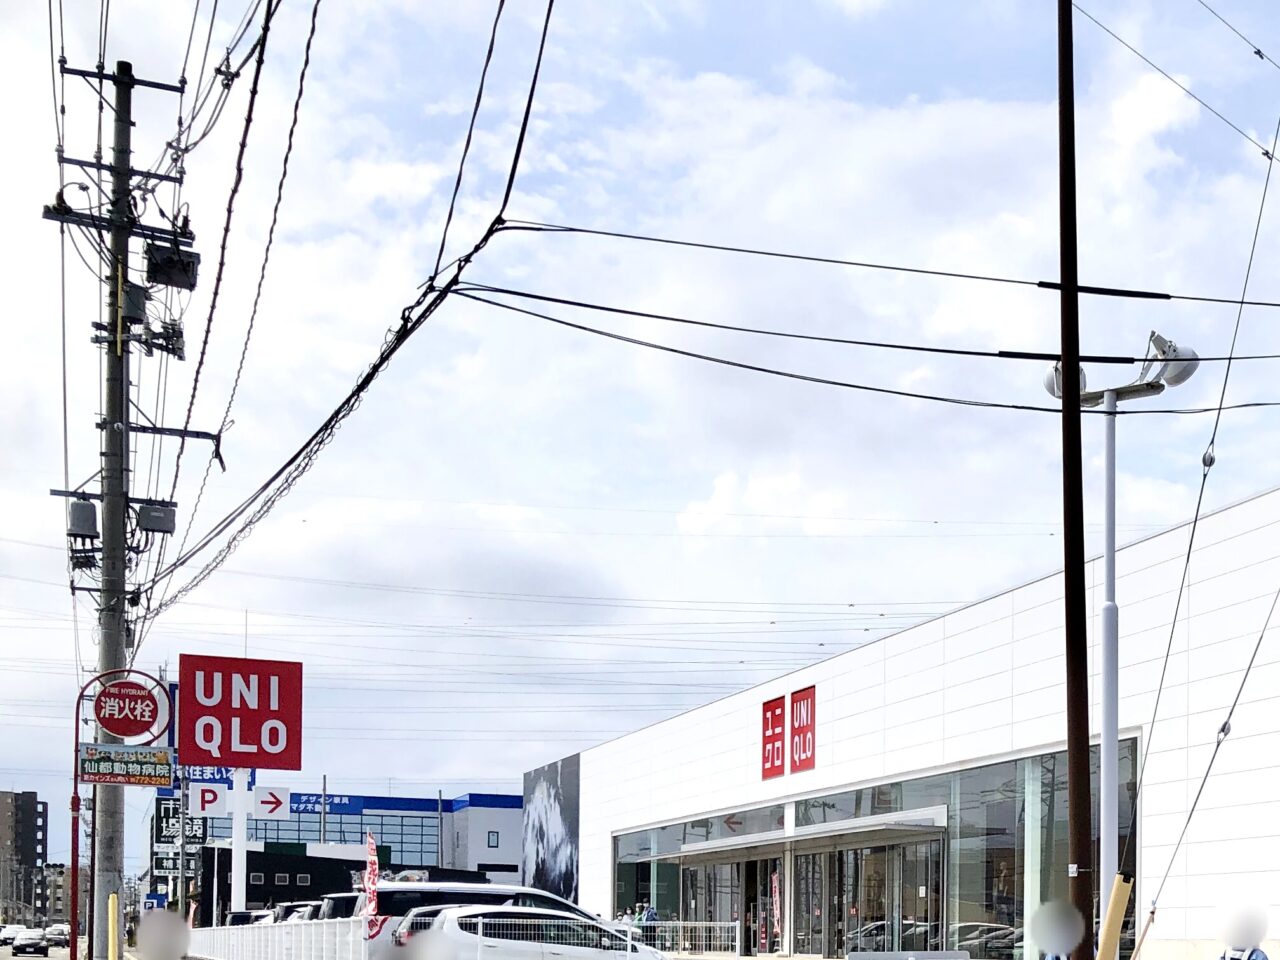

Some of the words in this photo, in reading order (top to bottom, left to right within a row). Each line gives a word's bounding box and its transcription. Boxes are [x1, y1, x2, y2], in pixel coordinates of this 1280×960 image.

[121, 688, 149, 696] HYDRANT
[195, 670, 279, 711] UNI
[100, 696, 154, 722] 消火栓
[793, 698, 812, 729] UNI
[194, 715, 287, 758] QLO
[793, 731, 813, 767] QLO
[84, 761, 170, 777] 仙都動物病院
[200, 788, 218, 811] P
